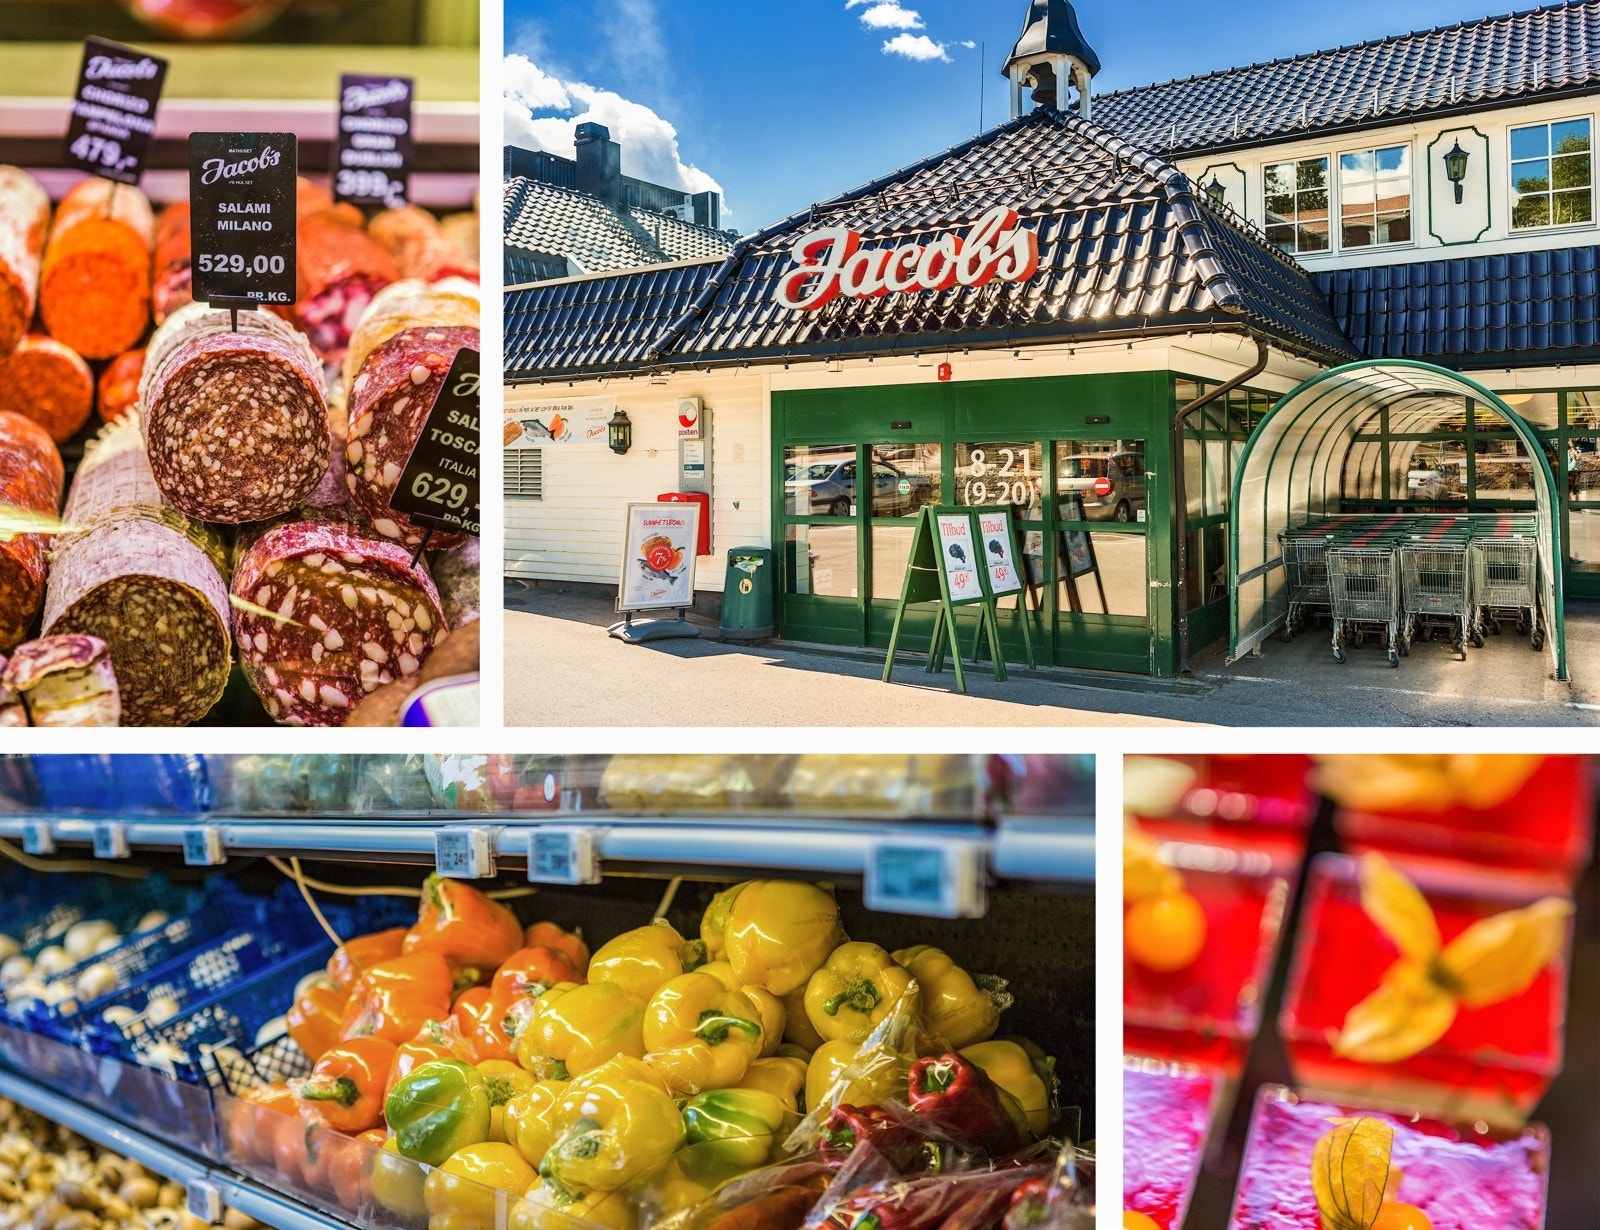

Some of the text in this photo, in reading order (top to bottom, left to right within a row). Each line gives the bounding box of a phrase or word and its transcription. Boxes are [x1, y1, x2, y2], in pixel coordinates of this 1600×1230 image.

[218, 203, 271, 214] SALAMI
[217, 220, 273, 231] MILANO
[198, 253, 285, 278] 529,00
[447, 410, 480, 432] SAL
[438, 457, 476, 478] ITALIA
[964, 480, 1035, 510] (9-20)
[941, 522, 966, 537] Tilbud
[981, 520, 1004, 534] Tilbud
